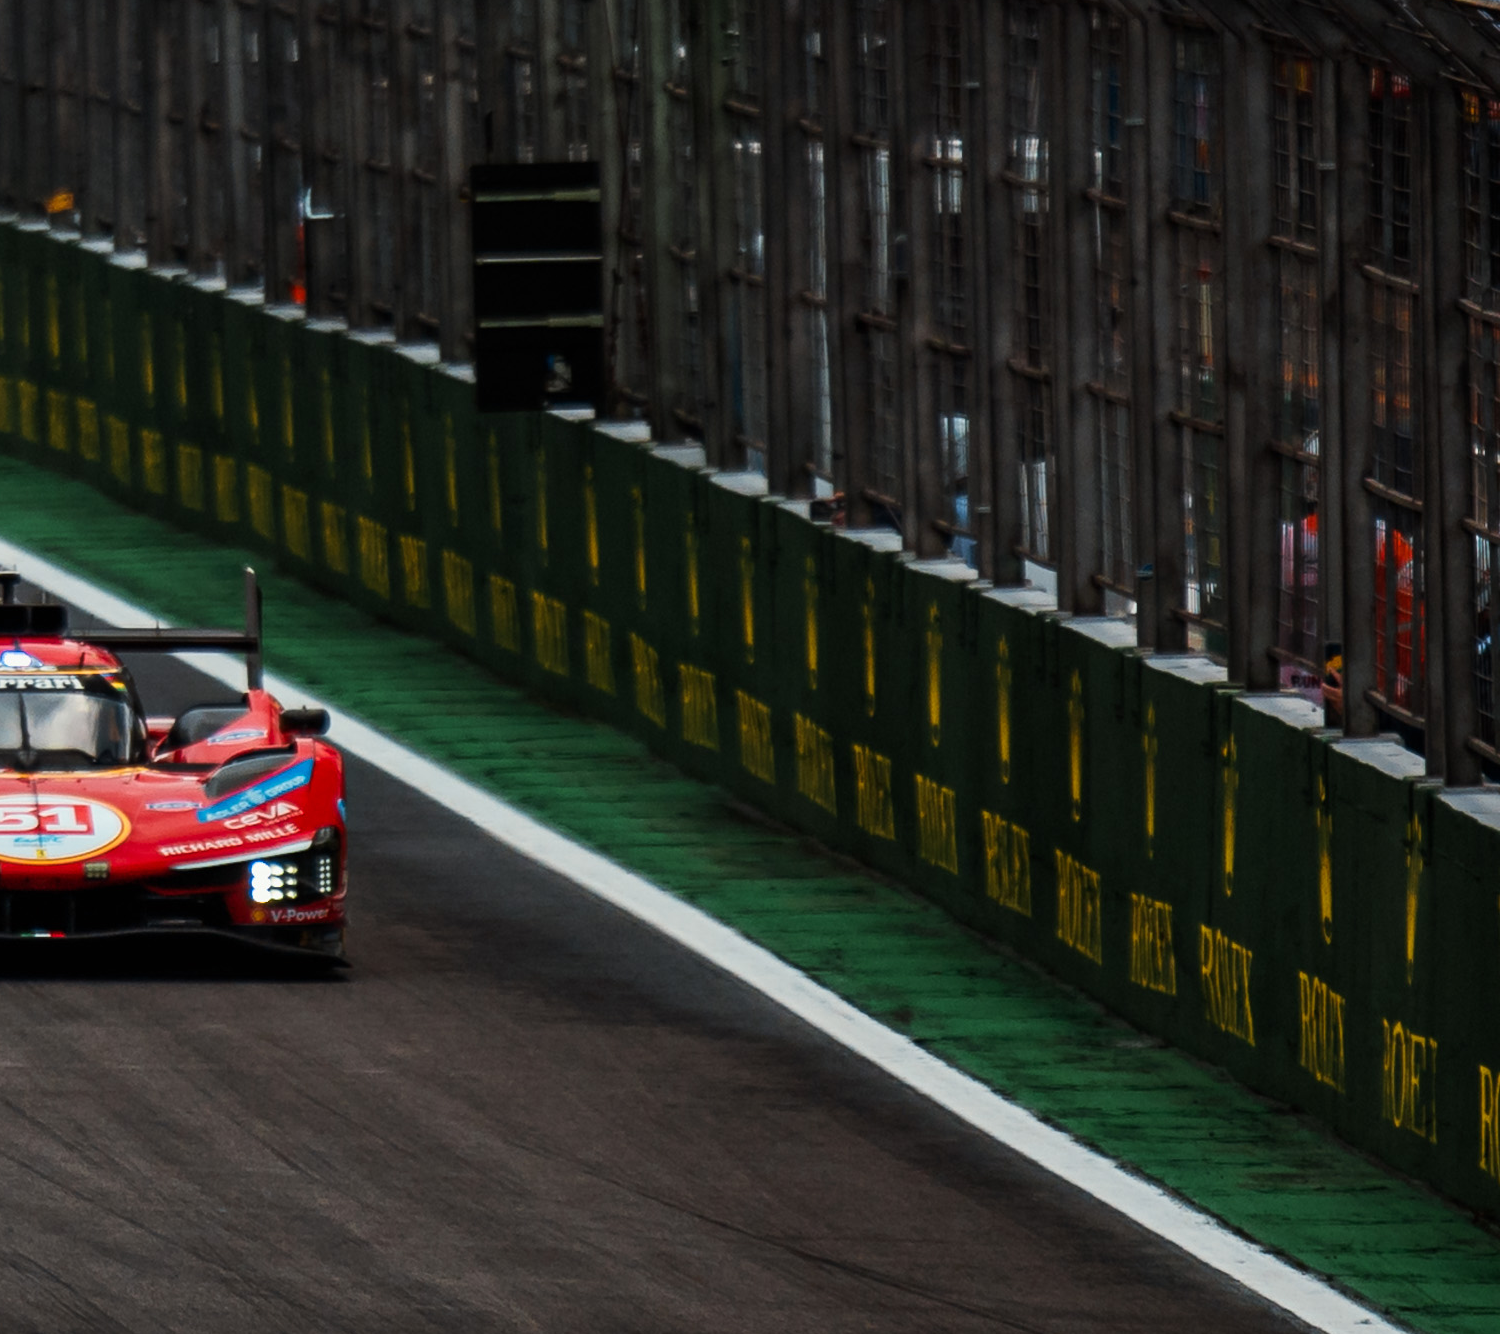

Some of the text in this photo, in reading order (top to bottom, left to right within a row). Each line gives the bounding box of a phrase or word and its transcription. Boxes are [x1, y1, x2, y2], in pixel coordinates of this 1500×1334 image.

[157, 823, 302, 858] RICHARD MILLE
[270, 906, 330, 924] V-Power
